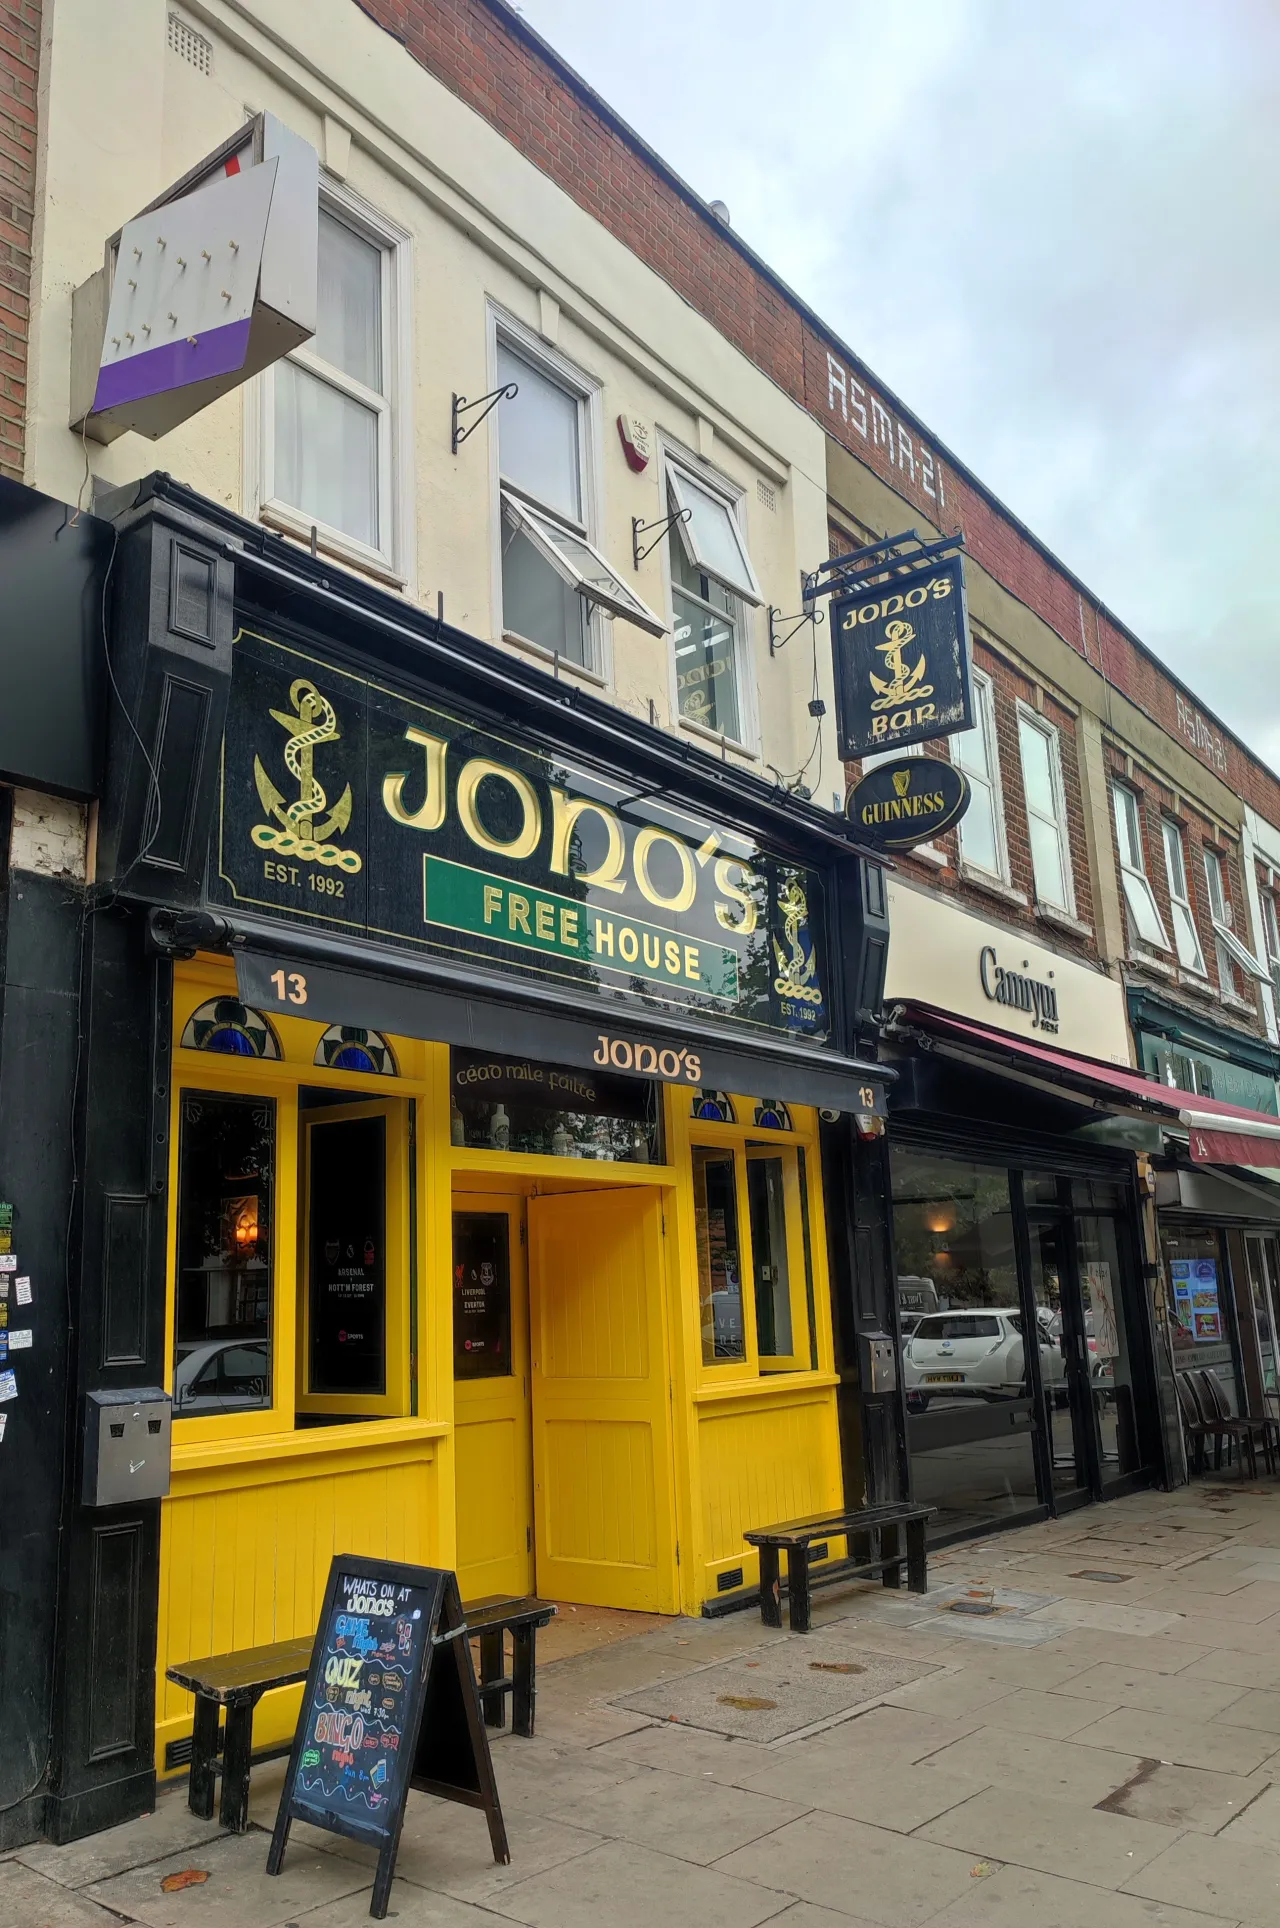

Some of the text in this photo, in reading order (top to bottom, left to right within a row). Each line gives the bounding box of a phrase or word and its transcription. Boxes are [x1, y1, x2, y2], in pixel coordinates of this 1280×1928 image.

[842, 577, 953, 631] JONO'S
[861, 791, 945, 826] GUINNESS
[381, 722, 758, 936] JONO'S
[263, 860, 345, 898] EST. 1992
[483, 884, 701, 981] FREE HOUSE
[270, 969, 308, 1005] 13
[980, 945, 1060, 1028] Camiyui
[780, 1001, 817, 1022] EST. 1992
[593, 1034, 702, 1082] JONO'S
[858, 1086, 874, 1108] 13
[328, 1283, 374, 1292] NOTT'M FOREST
[338, 1268, 365, 1276] ARSENAL
[461, 1288, 486, 1296] LIVERPOOL
[464, 1301, 485, 1309] EVERTON
[380, 1583, 395, 1598] ON
[397, 1587, 412, 1602] AT
[336, 1614, 370, 1637] GAME
[325, 1656, 363, 1689] QUIZ
[315, 1712, 363, 1752] BINGO
[345, 1766, 355, 1778] Sun
